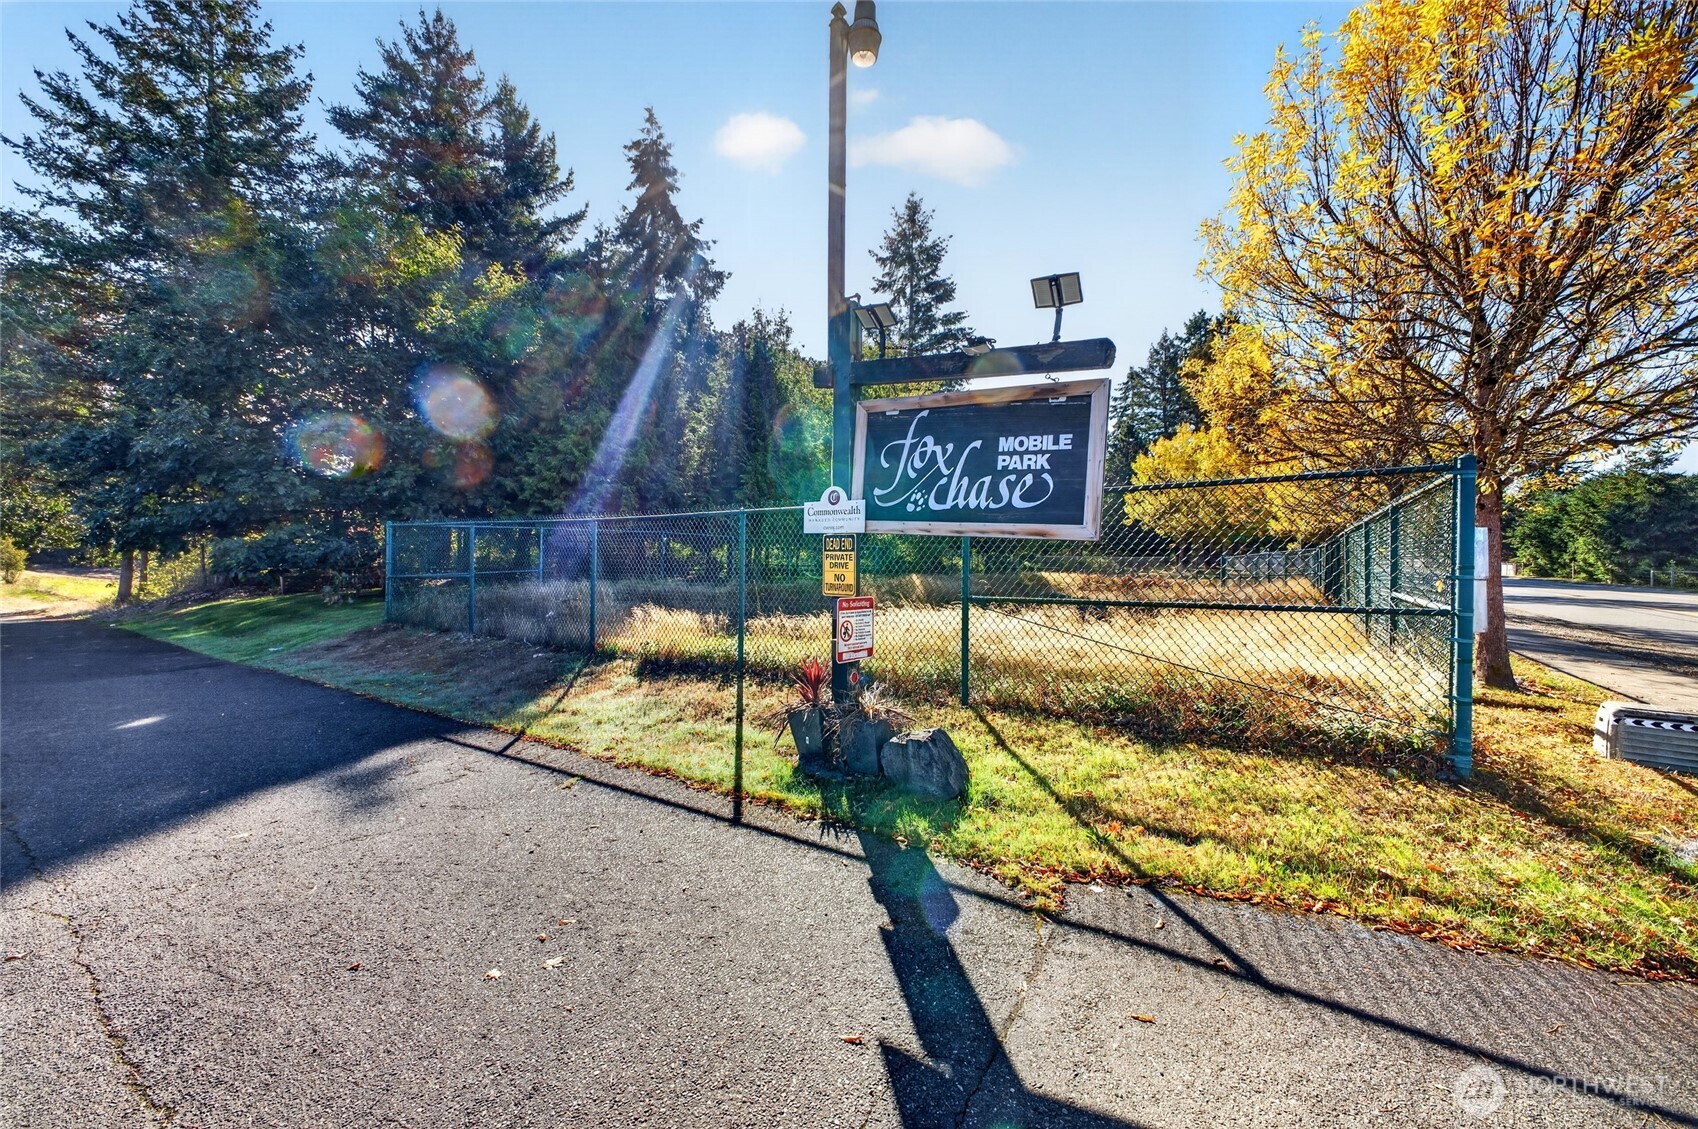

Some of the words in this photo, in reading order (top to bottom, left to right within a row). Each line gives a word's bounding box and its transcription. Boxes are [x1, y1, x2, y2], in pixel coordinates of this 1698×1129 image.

[998, 433, 1073, 453] MOBILE
[997, 453, 1051, 471] PARK
[807, 505, 861, 517] Commonwealth
[826, 538, 840, 550] DEAD
[841, 538, 853, 550] END
[825, 553, 853, 561] PRIVATE
[829, 562, 849, 570] DRIVE
[834, 574, 845, 582] NO
[825, 583, 853, 592] TURNAROUND
